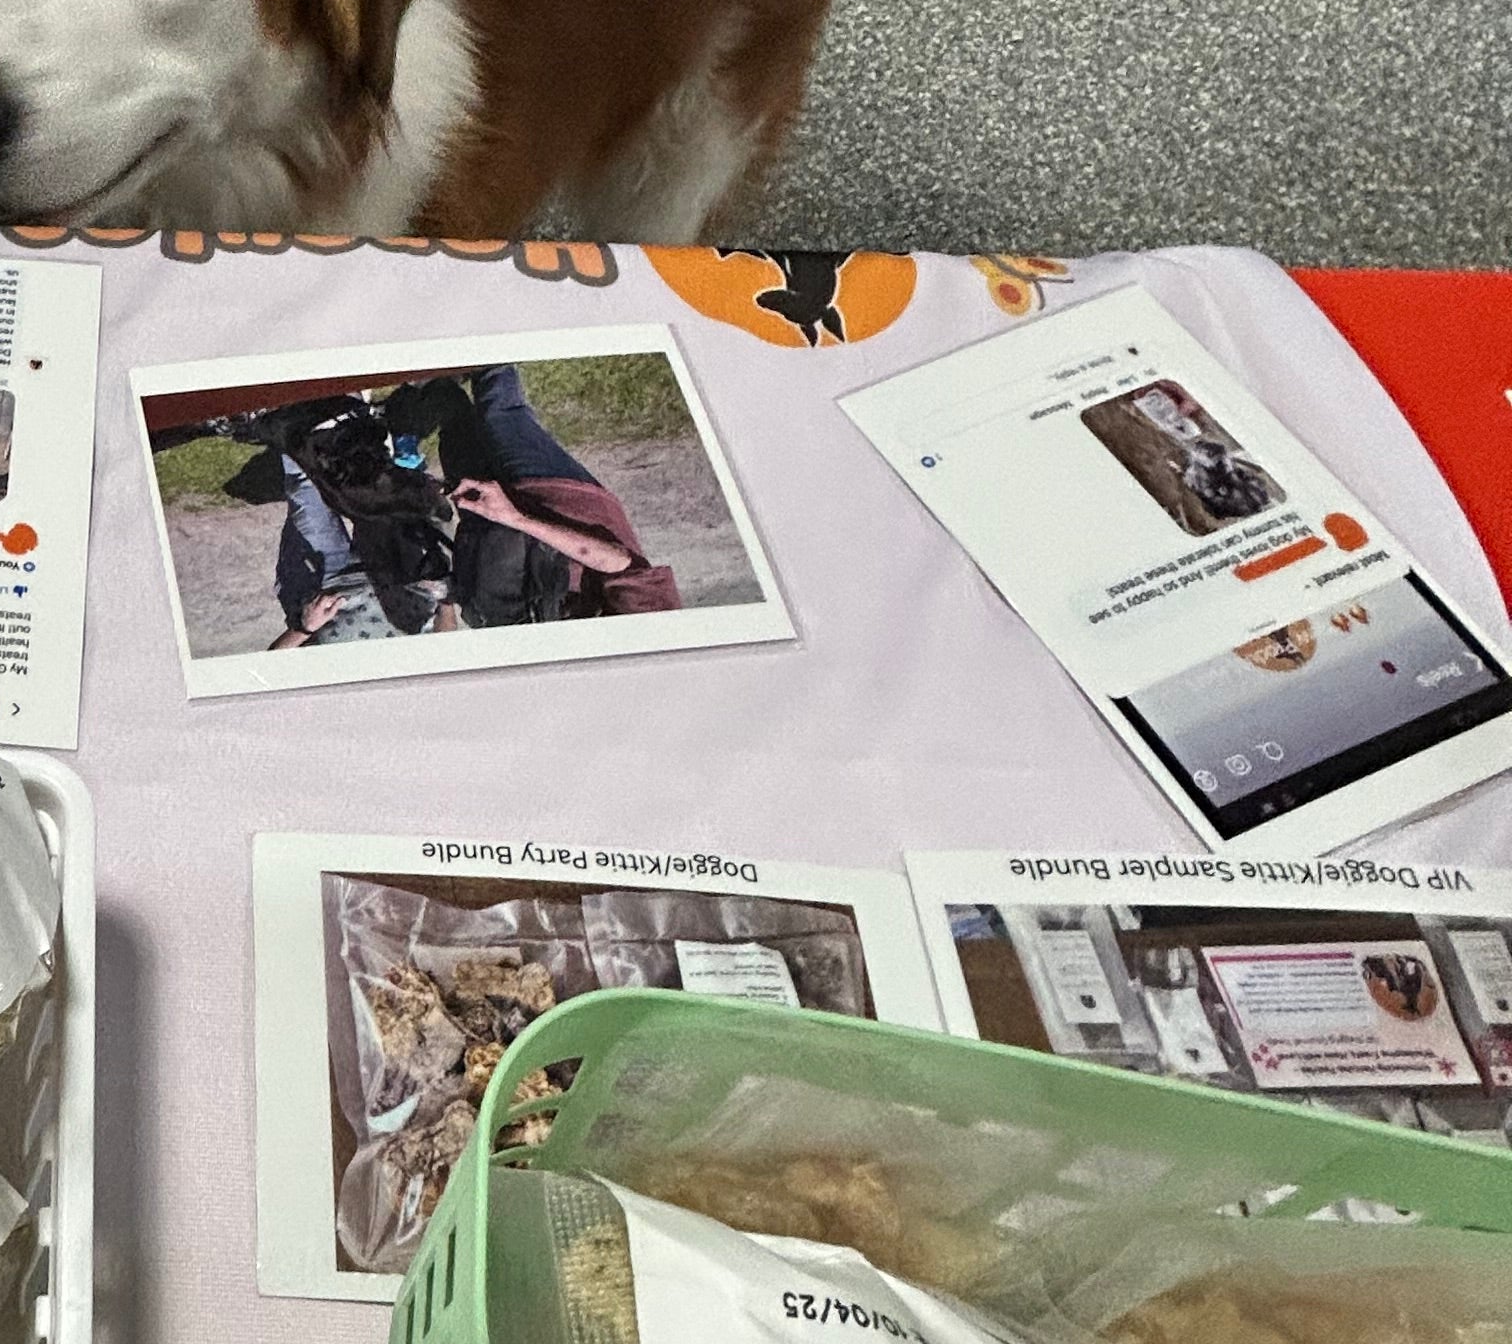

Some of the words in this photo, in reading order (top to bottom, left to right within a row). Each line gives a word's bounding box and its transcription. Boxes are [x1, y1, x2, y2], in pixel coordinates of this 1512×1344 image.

[0, 561, 20, 571] You
[0, 611, 32, 622] treats
[8, 625, 32, 634] out!
[10, 663, 28, 675] My
[421, 842, 512, 865] Bundle
[521, 843, 587, 869] Party
[595, 852, 758, 883] Doggie/Kittie
[1009, 858, 1109, 881] Bundle
[1121, 857, 1231, 882] Sampler
[1241, 859, 1419, 889] Doggie/Kittie
[1428, 868, 1471, 891] VIP
